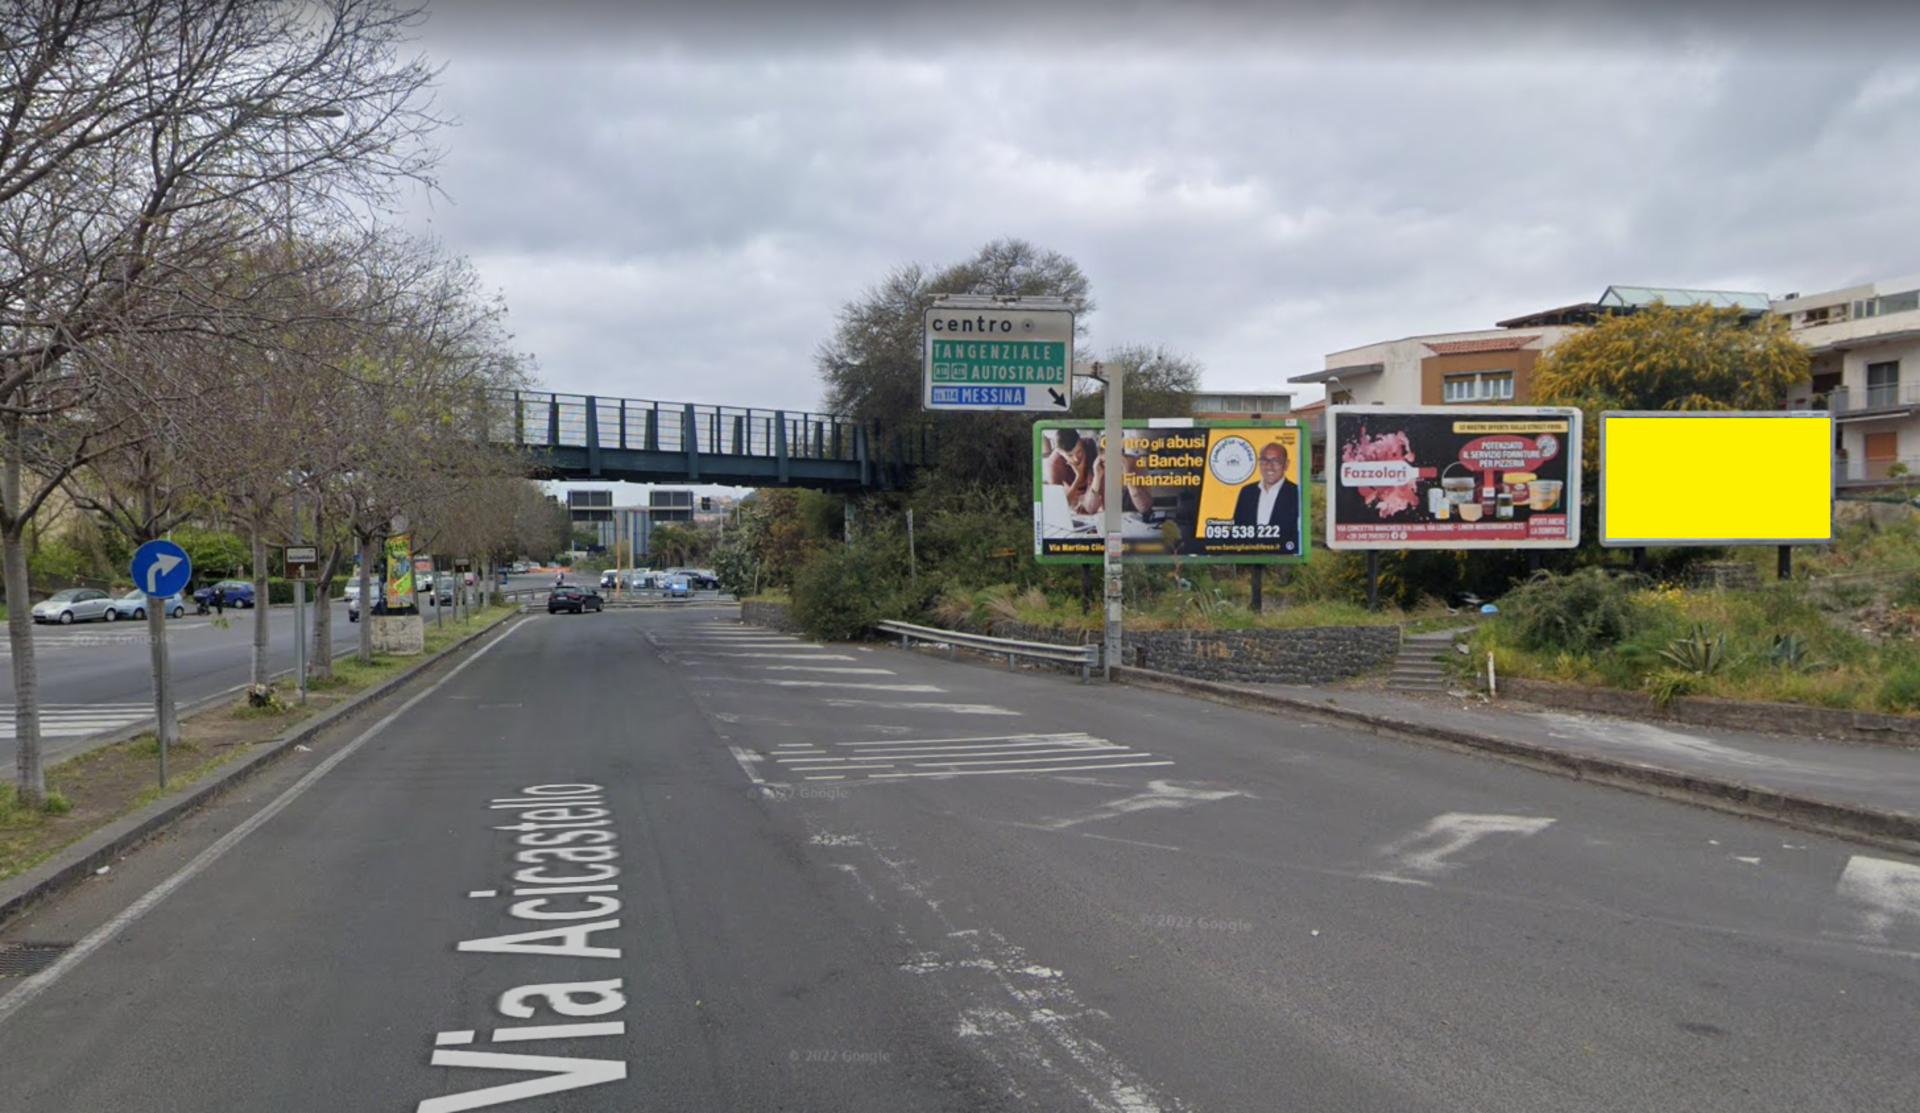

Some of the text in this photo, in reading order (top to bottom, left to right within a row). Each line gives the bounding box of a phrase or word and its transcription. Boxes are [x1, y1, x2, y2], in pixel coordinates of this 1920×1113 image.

[932, 316, 1012, 332] centro
[934, 344, 1051, 360] TANGENZIALE
[971, 365, 1063, 381] AUTOSTRADE
[962, 388, 1023, 403] MESSINA
[1166, 434, 1206, 449] abusi
[1136, 453, 1203, 468] di Banche
[1122, 472, 1200, 486] Finanziarie
[1344, 466, 1405, 479] Fazzolari
[1206, 525, 1280, 538] 095 538 222
